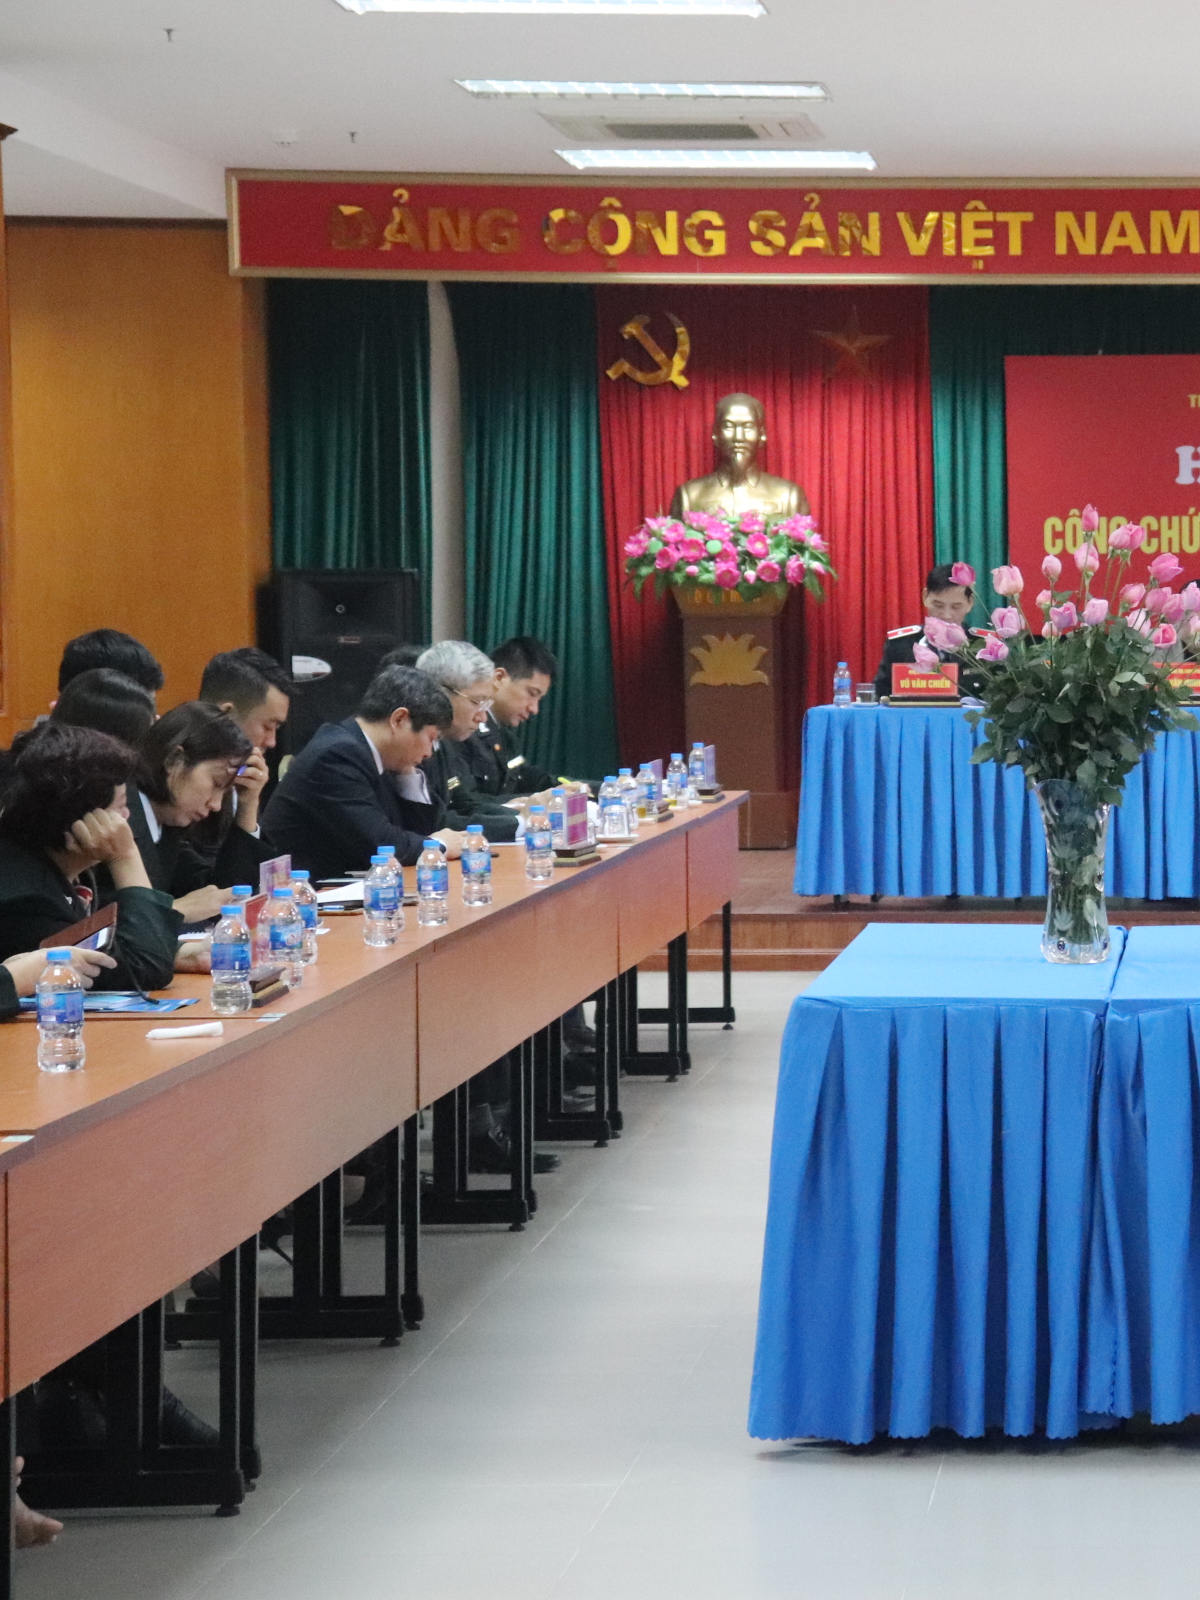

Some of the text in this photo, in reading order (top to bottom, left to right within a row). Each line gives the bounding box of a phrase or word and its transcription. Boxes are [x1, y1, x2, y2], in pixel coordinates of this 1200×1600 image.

[542, 197, 727, 269] CỘNG
[748, 193, 881, 257] SẢN
[897, 200, 1034, 270] VIỆT
[1055, 210, 1200, 256] NAM
